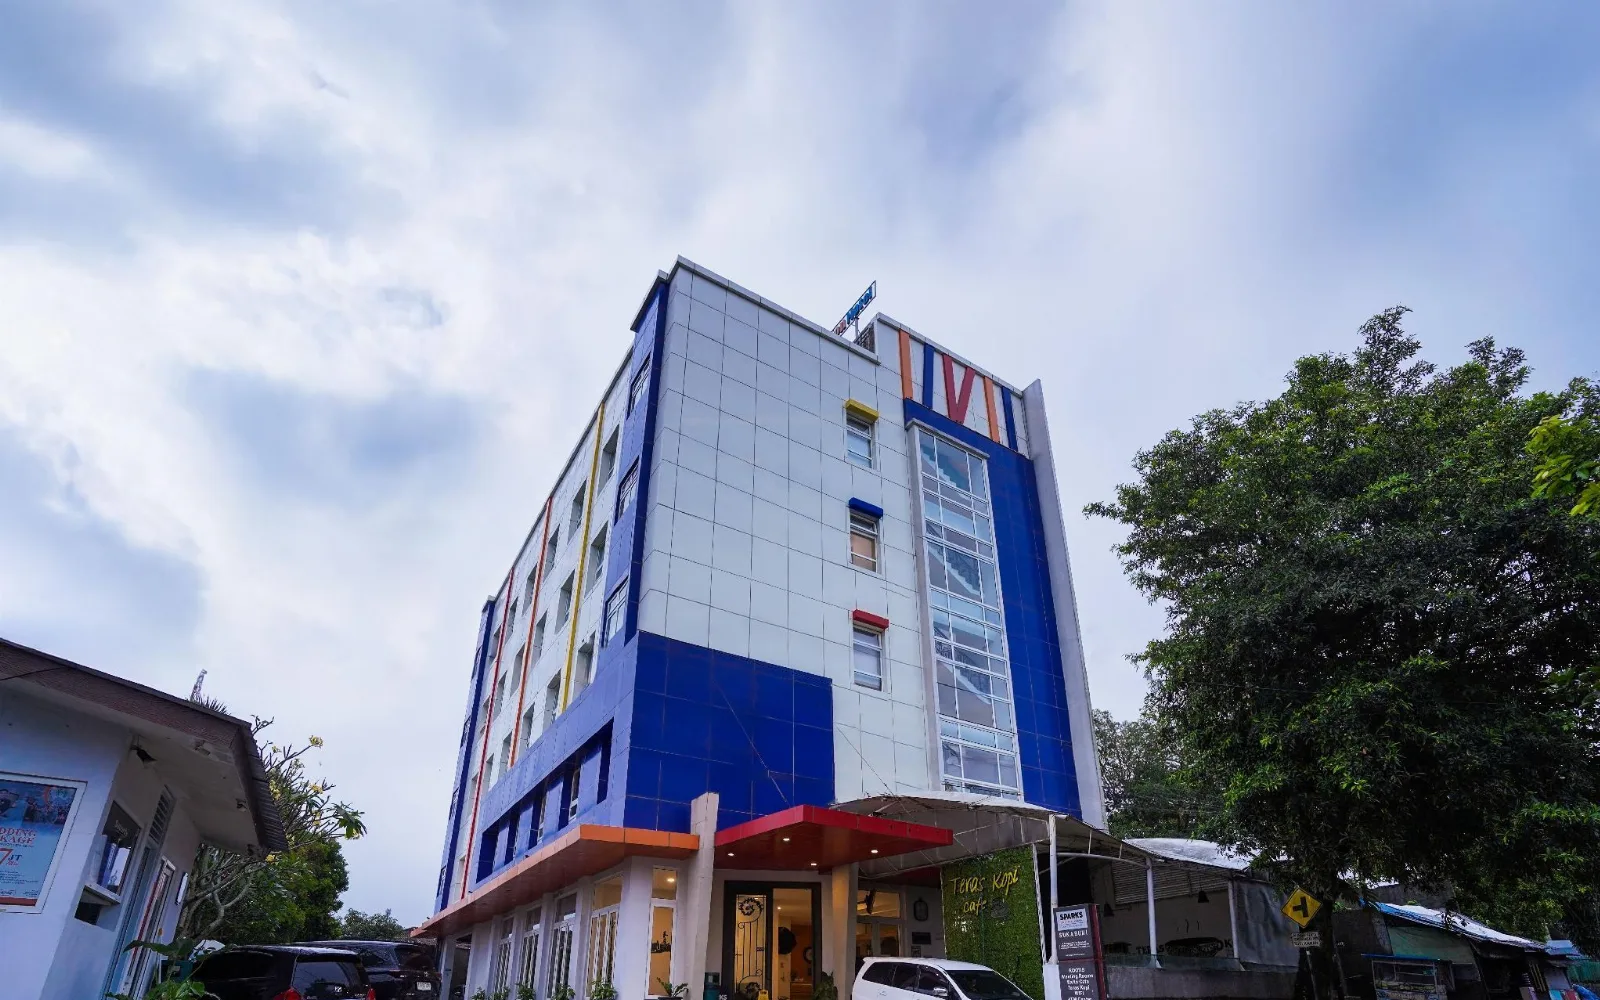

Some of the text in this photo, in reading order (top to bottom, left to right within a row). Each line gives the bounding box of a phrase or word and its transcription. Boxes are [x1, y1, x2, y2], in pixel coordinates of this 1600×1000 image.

[846, 285, 872, 324] Hotel
[949, 865, 1020, 896] Teras Kopi
[1060, 912, 1083, 920] SPARKS
